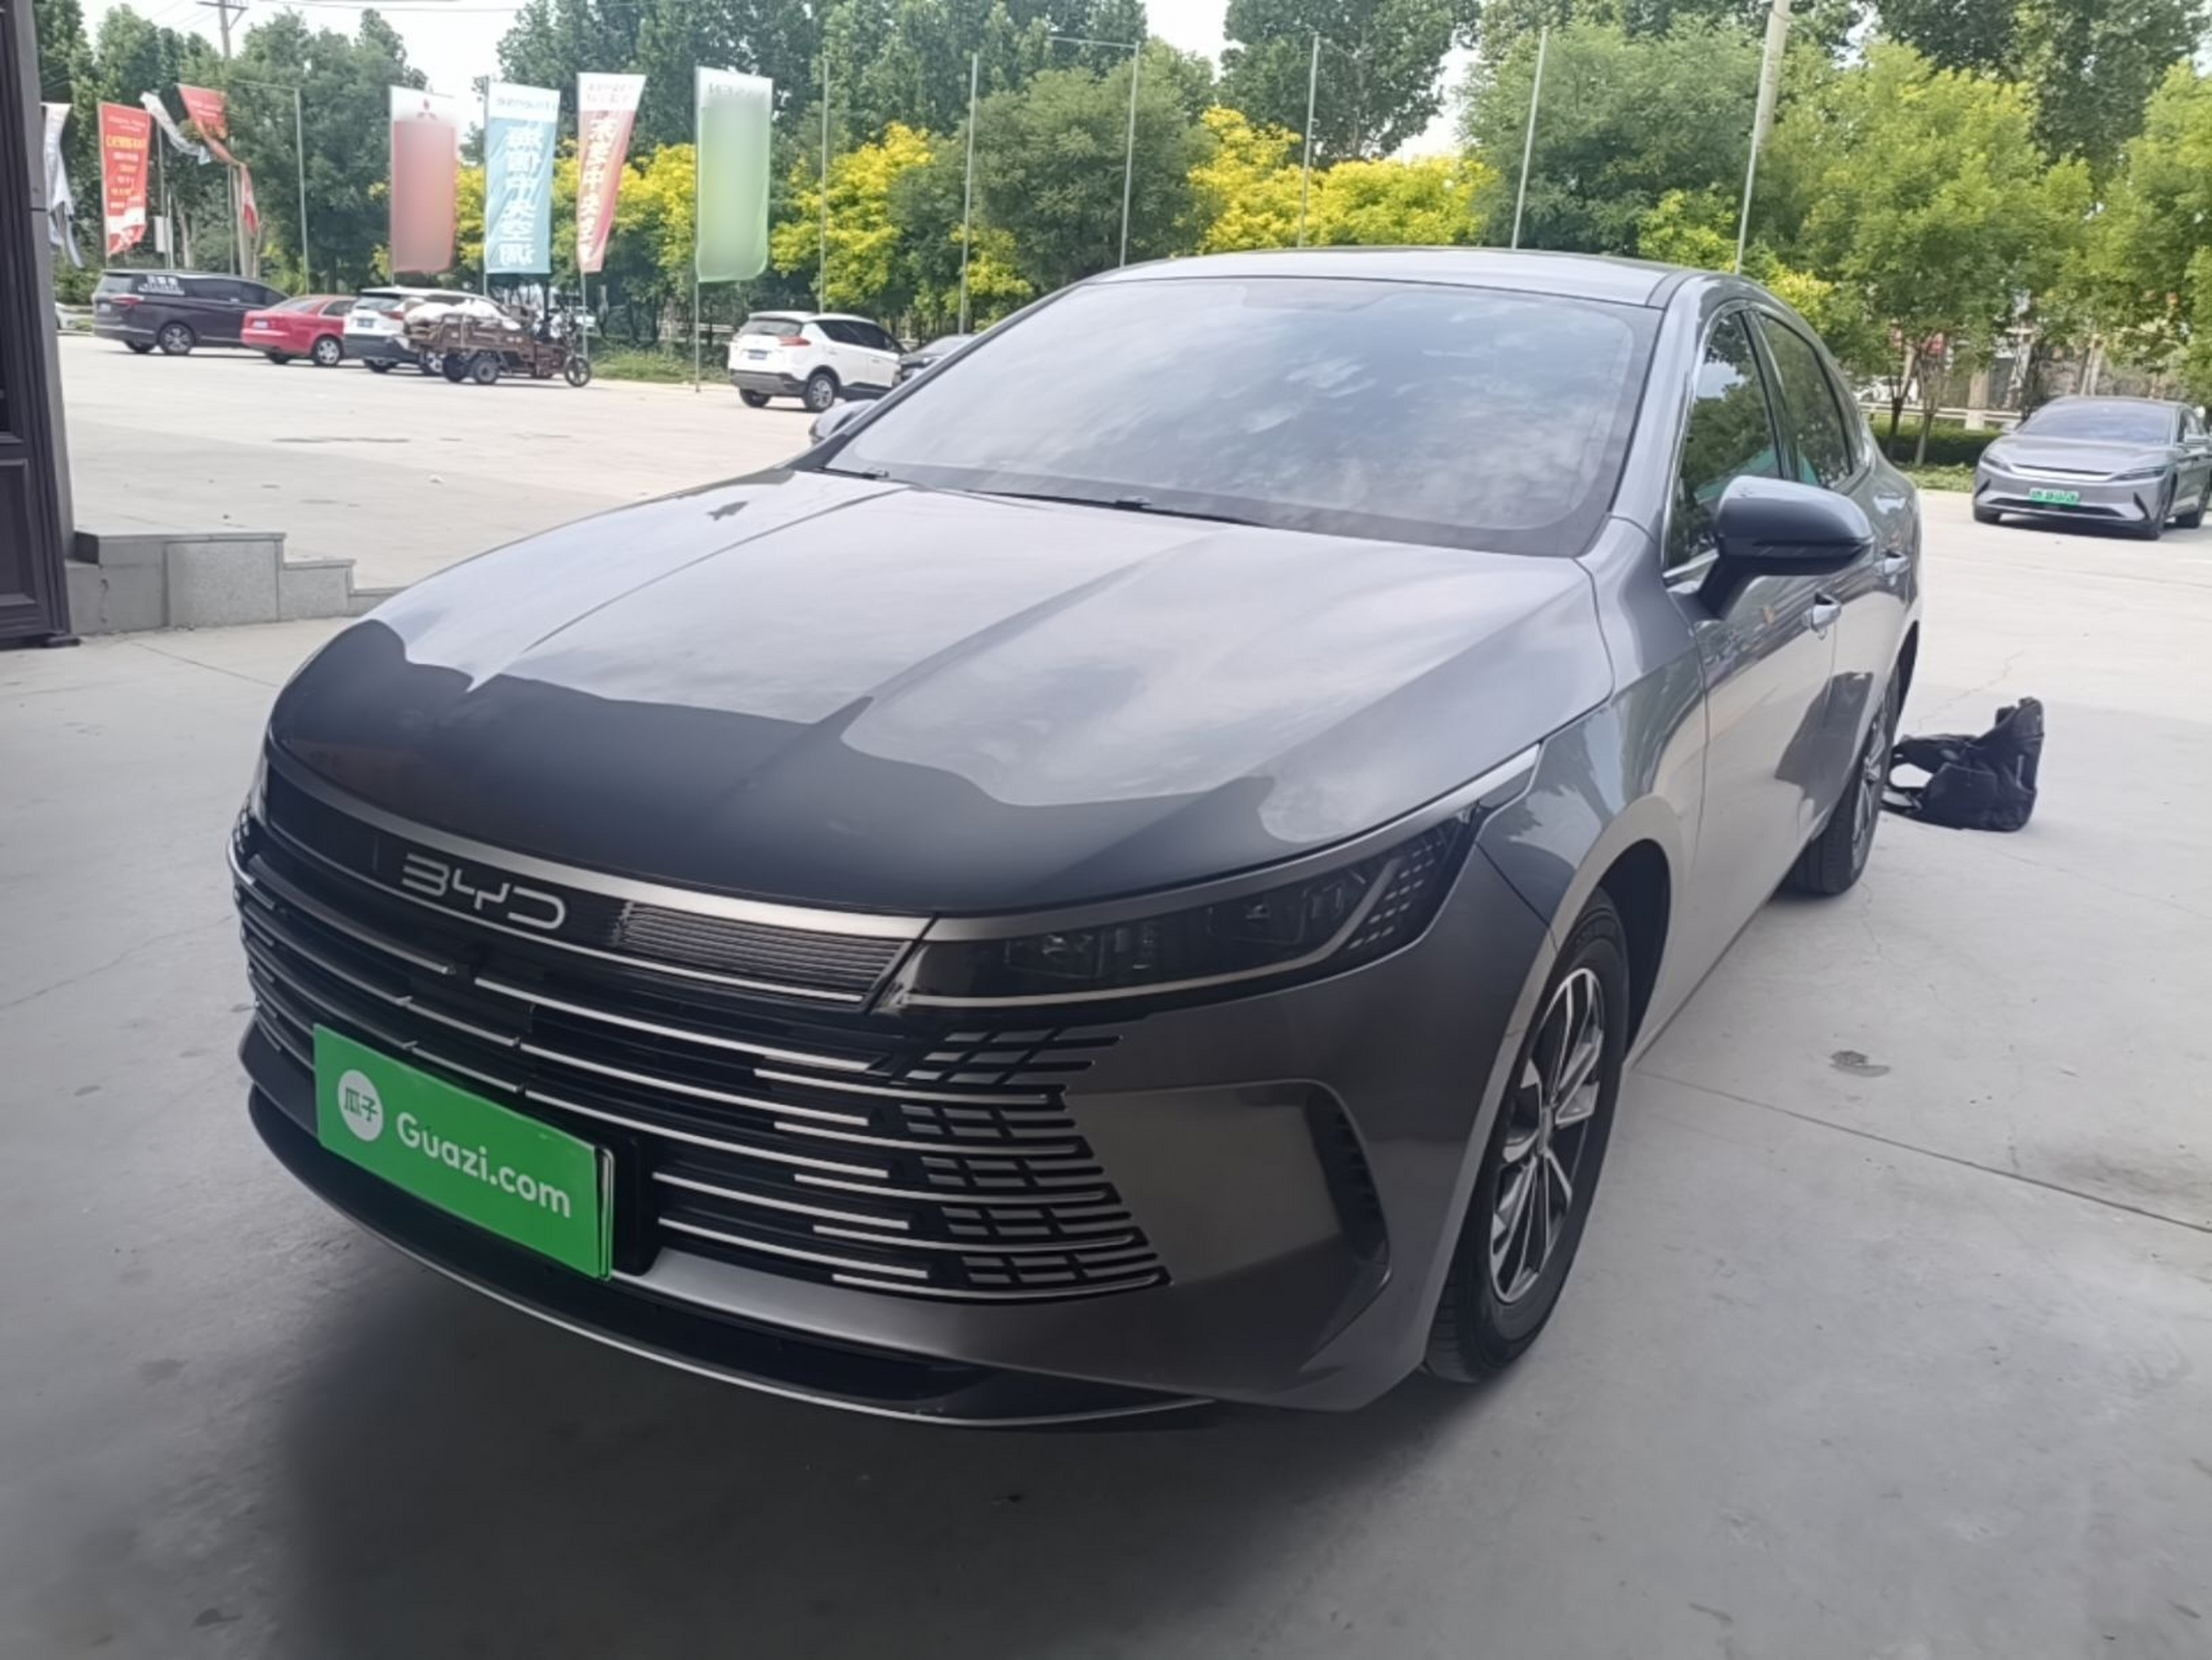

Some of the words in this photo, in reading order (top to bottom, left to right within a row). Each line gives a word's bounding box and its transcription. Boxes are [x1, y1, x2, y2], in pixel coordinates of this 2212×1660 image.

[402, 853, 565, 930] BYD
[343, 1087, 378, 1122] 瓜子
[397, 1112, 571, 1219] Guazi.com
